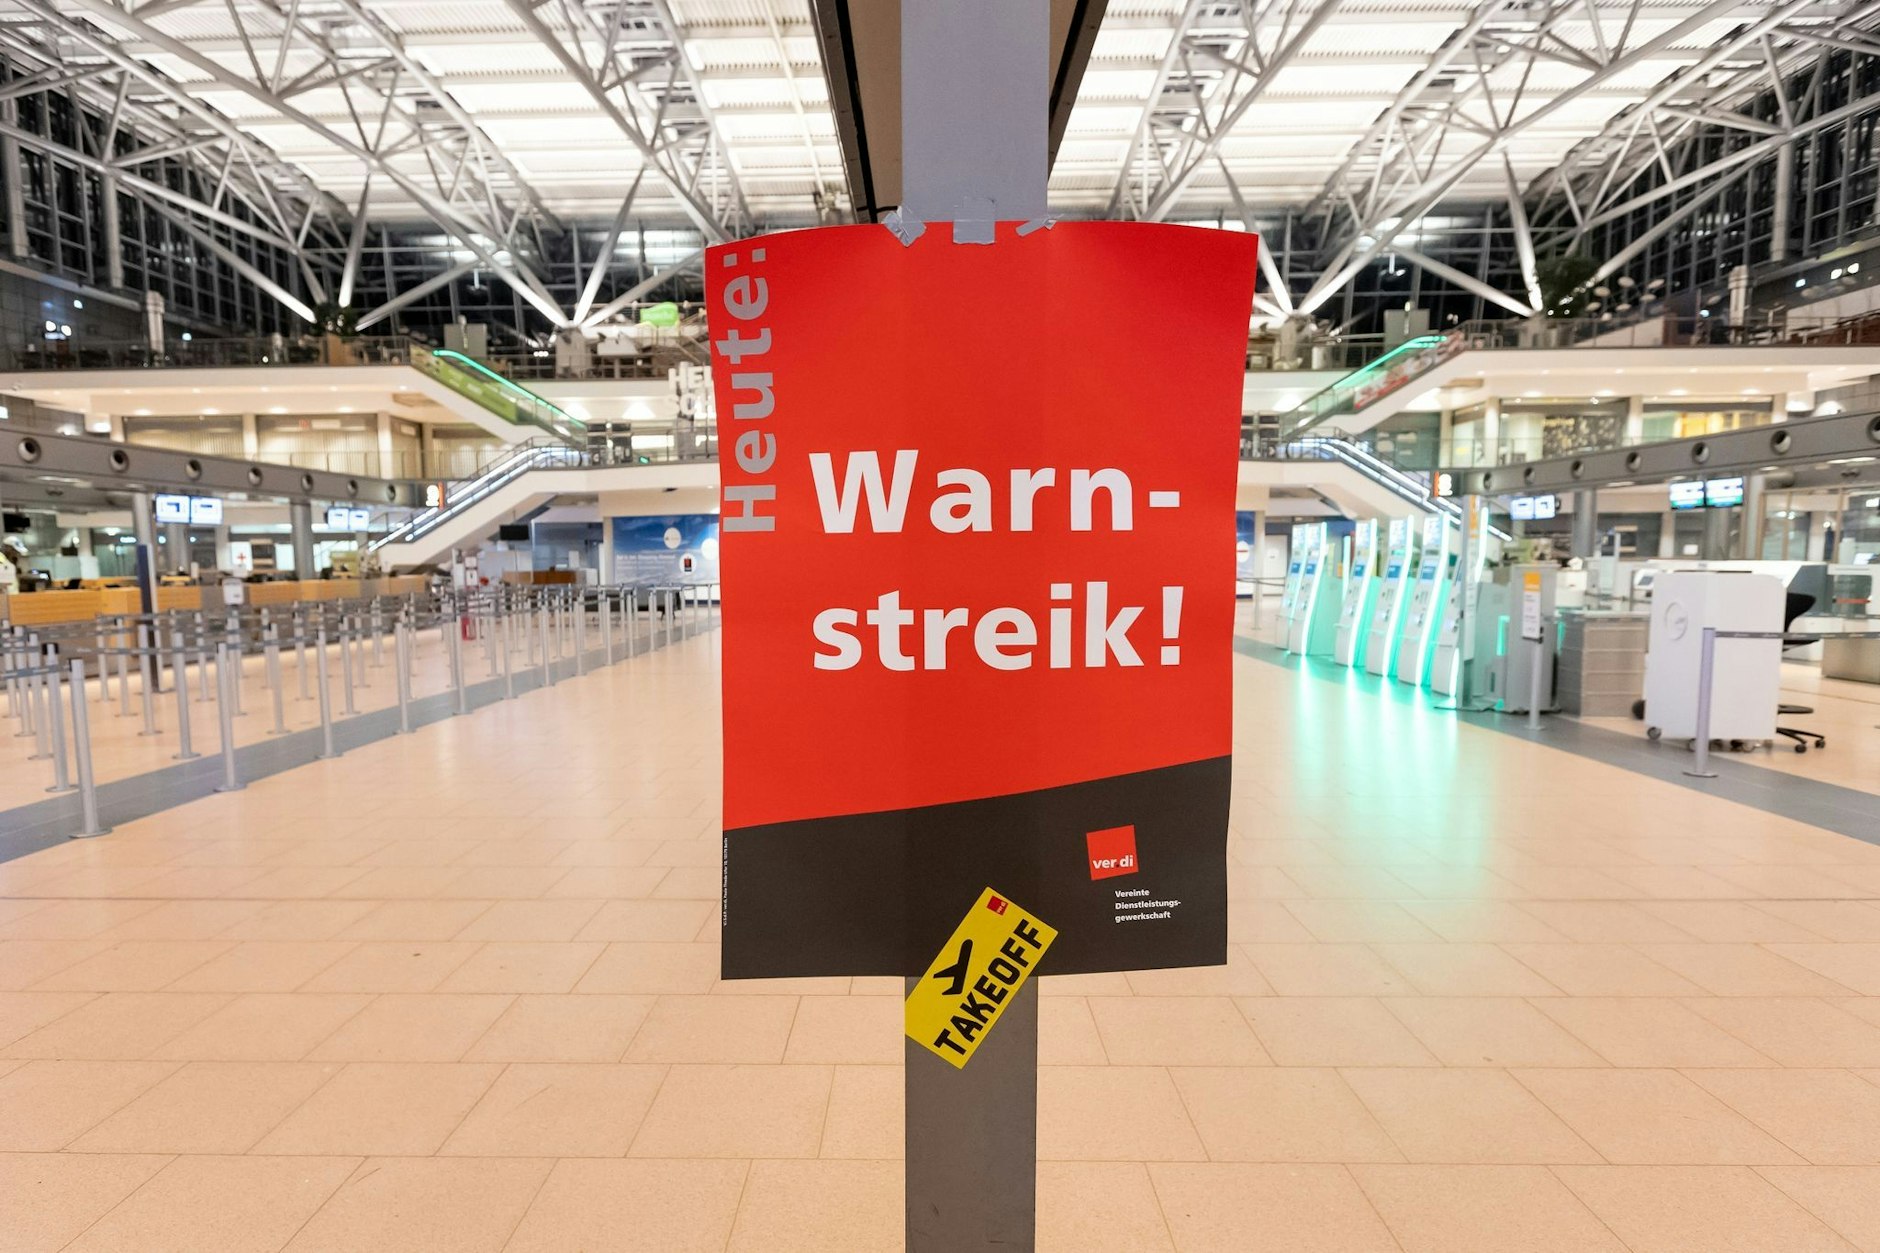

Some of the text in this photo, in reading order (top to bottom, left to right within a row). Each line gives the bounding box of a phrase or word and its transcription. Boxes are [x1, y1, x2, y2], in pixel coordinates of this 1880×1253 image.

[715, 248, 777, 532] Heute:
[809, 449, 1181, 534] Warn-
[813, 581, 1184, 672] streik!
[1092, 855, 1135, 870] ver.di
[1114, 888, 1150, 898] Vereinte
[1114, 910, 1171, 923] gewerkschaft
[1115, 899, 1182, 911] Dienstleistungs-
[933, 918, 1044, 1056] TAKEOFF
